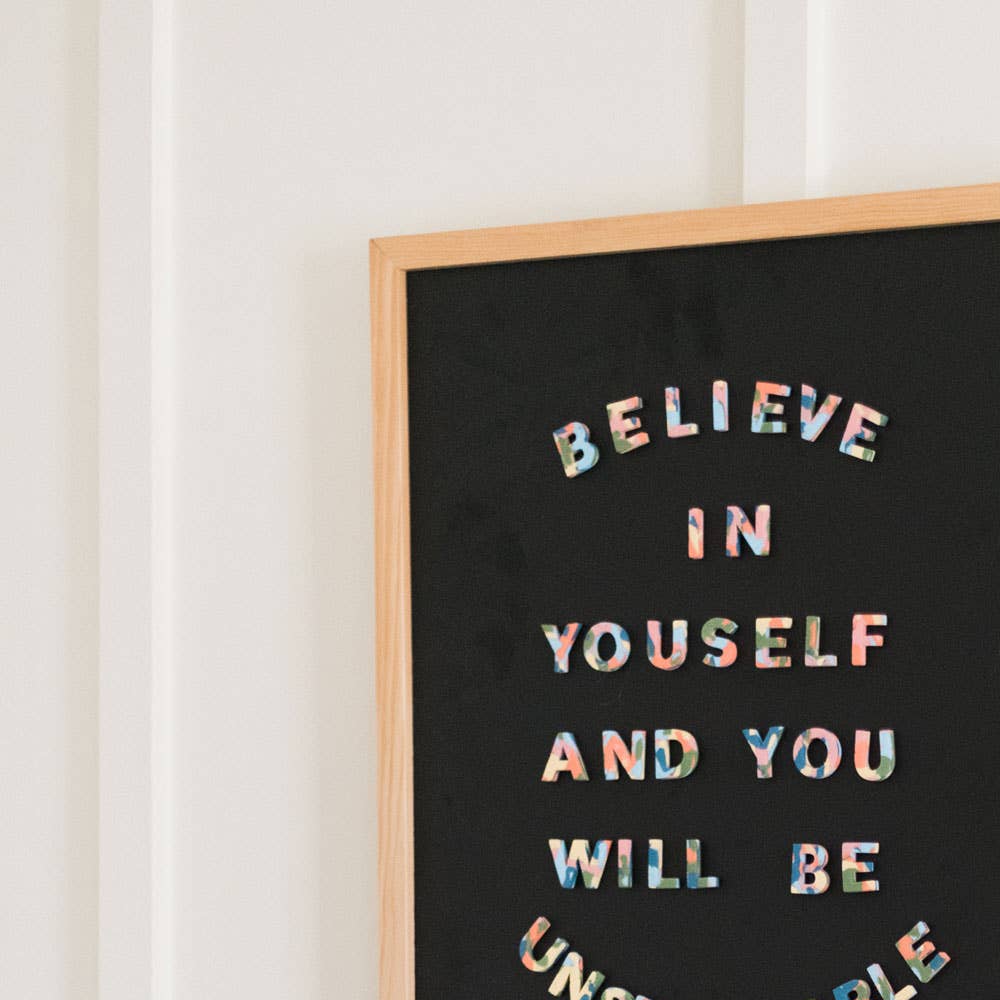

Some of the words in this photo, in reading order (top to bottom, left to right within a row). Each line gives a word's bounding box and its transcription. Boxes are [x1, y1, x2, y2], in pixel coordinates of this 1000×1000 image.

[553, 379, 889, 479] BELIEVE
[686, 504, 772, 561] IN
[540, 613, 888, 674] YOUSELF
[540, 727, 701, 783] AND
[741, 726, 896, 782] YOU
[547, 838, 720, 890] WILL
[789, 842, 880, 895] BE
